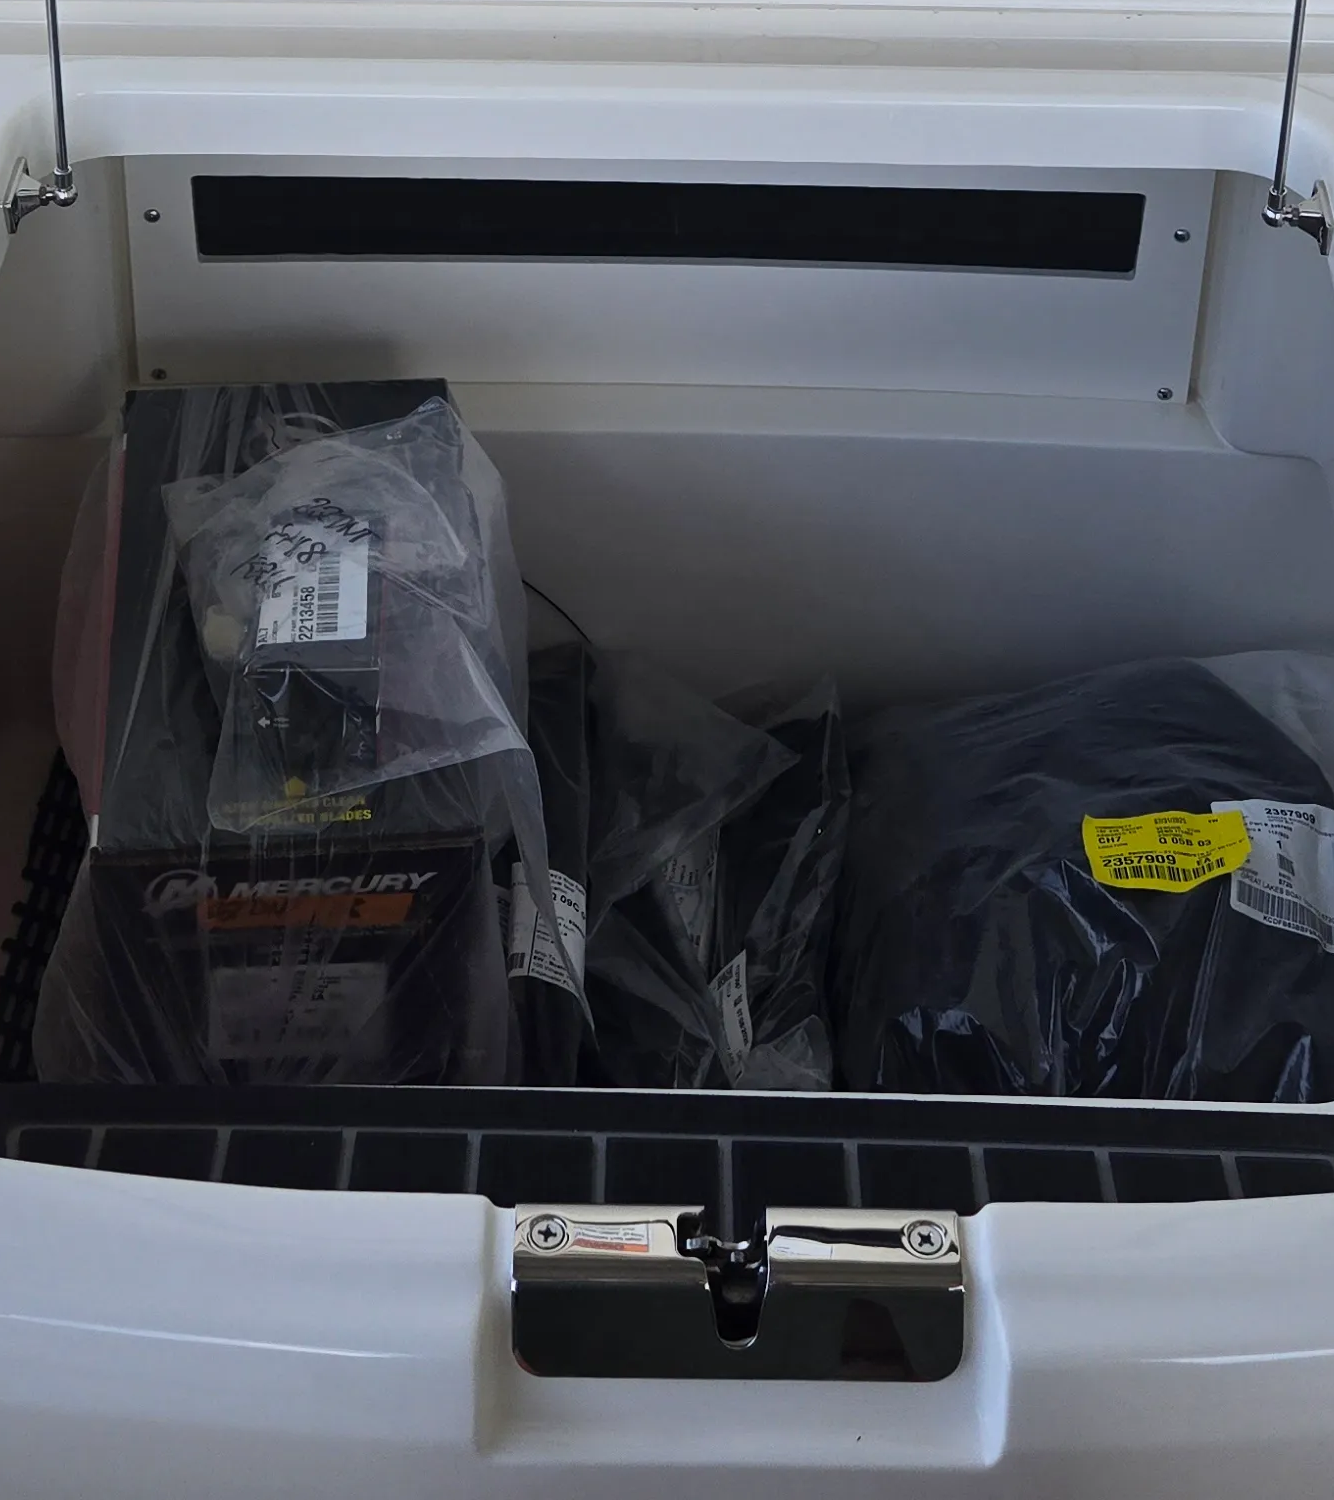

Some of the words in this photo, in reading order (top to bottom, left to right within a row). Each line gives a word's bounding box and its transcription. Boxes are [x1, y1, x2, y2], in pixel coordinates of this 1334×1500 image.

[298, 586, 316, 641] 2213458
[1264, 807, 1316, 825] 2357909
[1158, 837, 1168, 845] Q
[1198, 839, 1212, 847] 03
[1102, 854, 1177, 868] 2357909
[228, 871, 438, 900] MERCURY
[1262, 880, 1285, 896] LAKES
